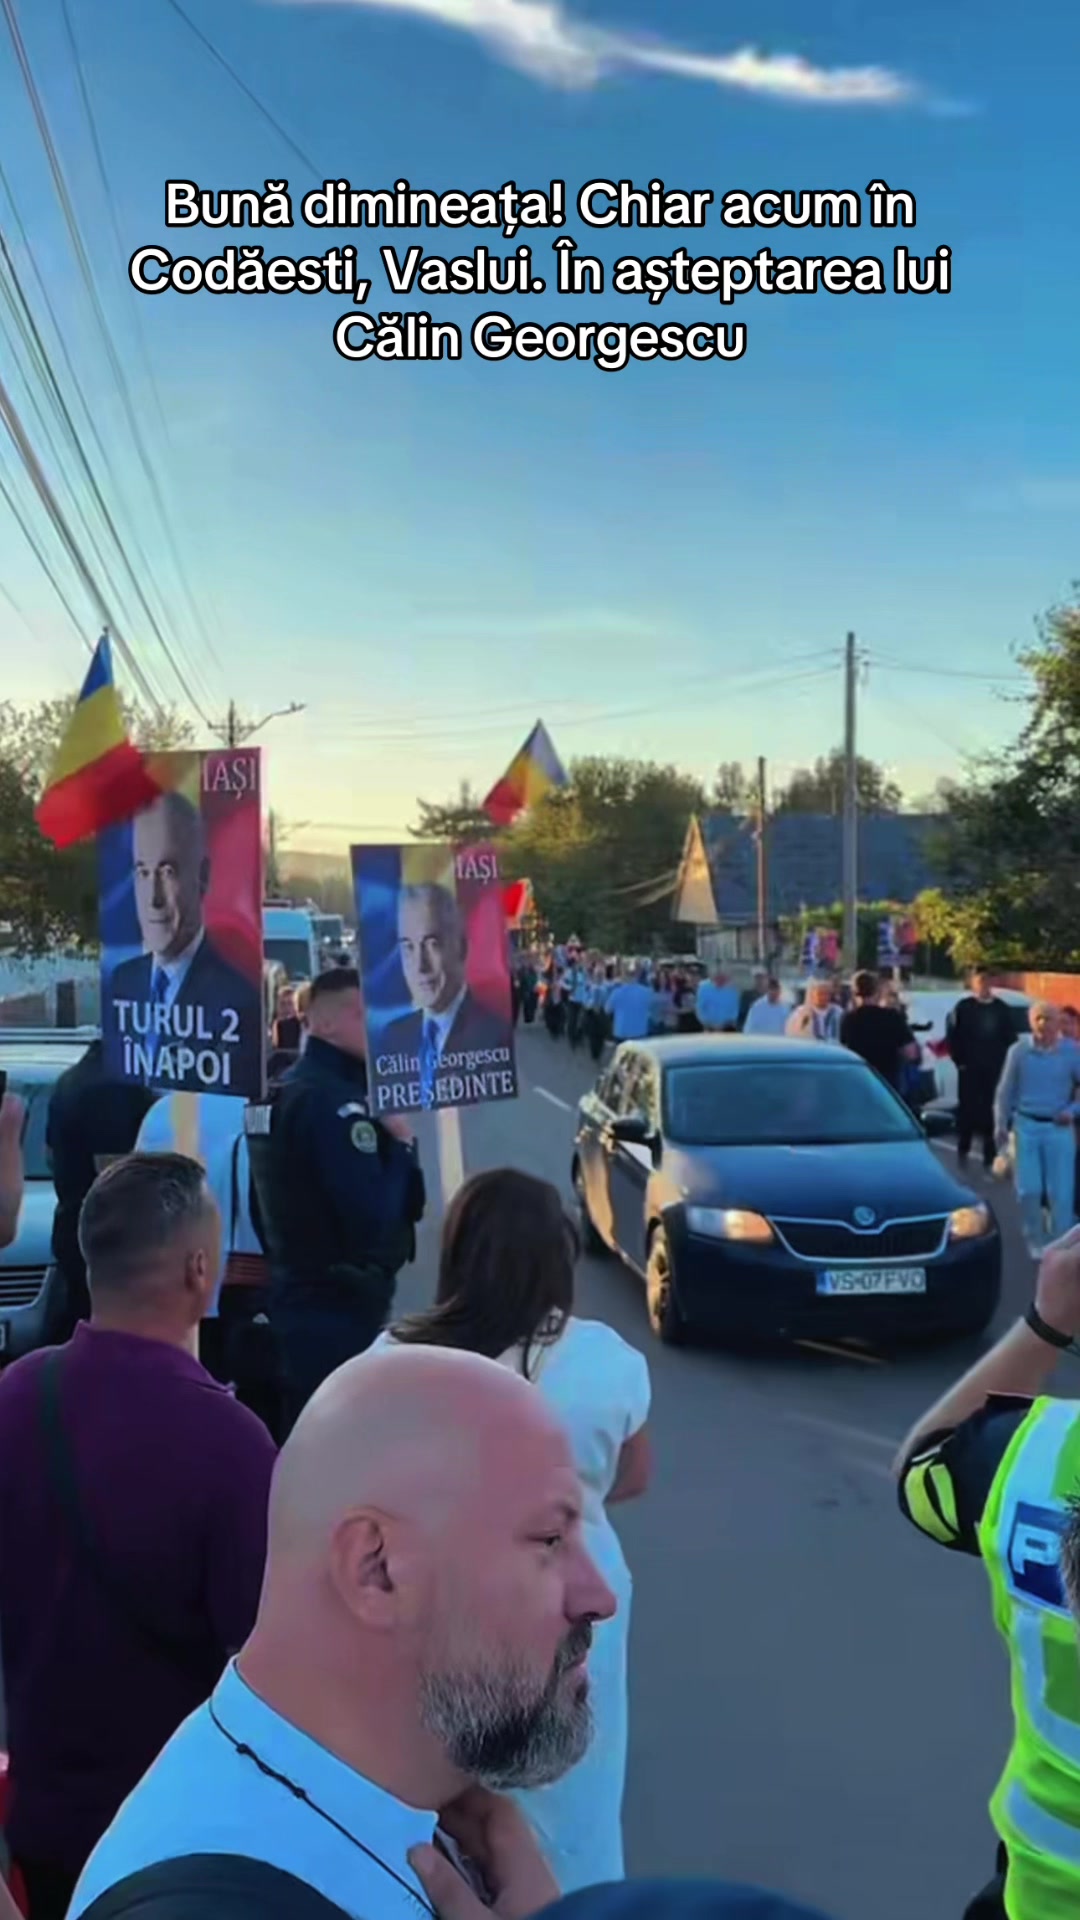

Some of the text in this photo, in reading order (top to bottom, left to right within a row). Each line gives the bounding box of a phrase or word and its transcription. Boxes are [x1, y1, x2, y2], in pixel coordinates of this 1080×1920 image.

[203, 757, 256, 800] IAȘI
[457, 854, 497, 885] IAȘI
[112, 999, 240, 1042] TURUL 2
[123, 1035, 230, 1085] ÎNAPOI
[375, 1047, 510, 1076] Călin Georgescu
[377, 1070, 514, 1110] PREȘEDINTE
